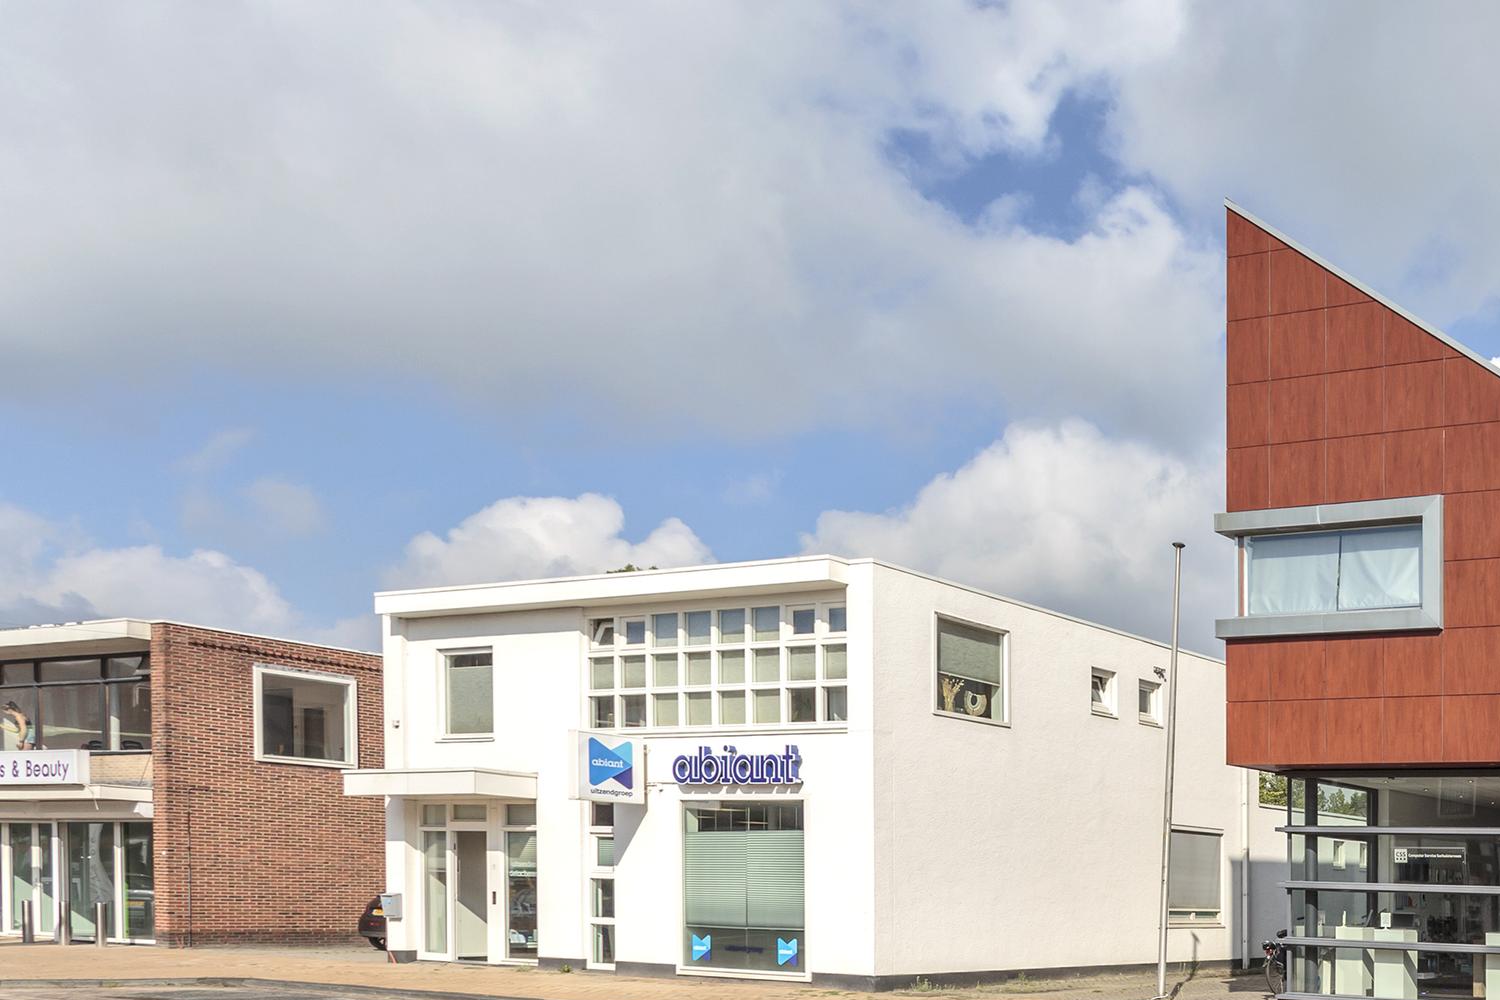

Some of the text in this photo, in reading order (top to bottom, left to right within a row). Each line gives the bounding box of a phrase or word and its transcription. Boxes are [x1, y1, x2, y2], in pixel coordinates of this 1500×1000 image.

[11, 759, 20, 777] &
[26, 760, 69, 781] Beauty
[591, 758, 624, 769] abiant
[672, 744, 798, 784] abiant
[590, 788, 634, 798] uitzendgroep
